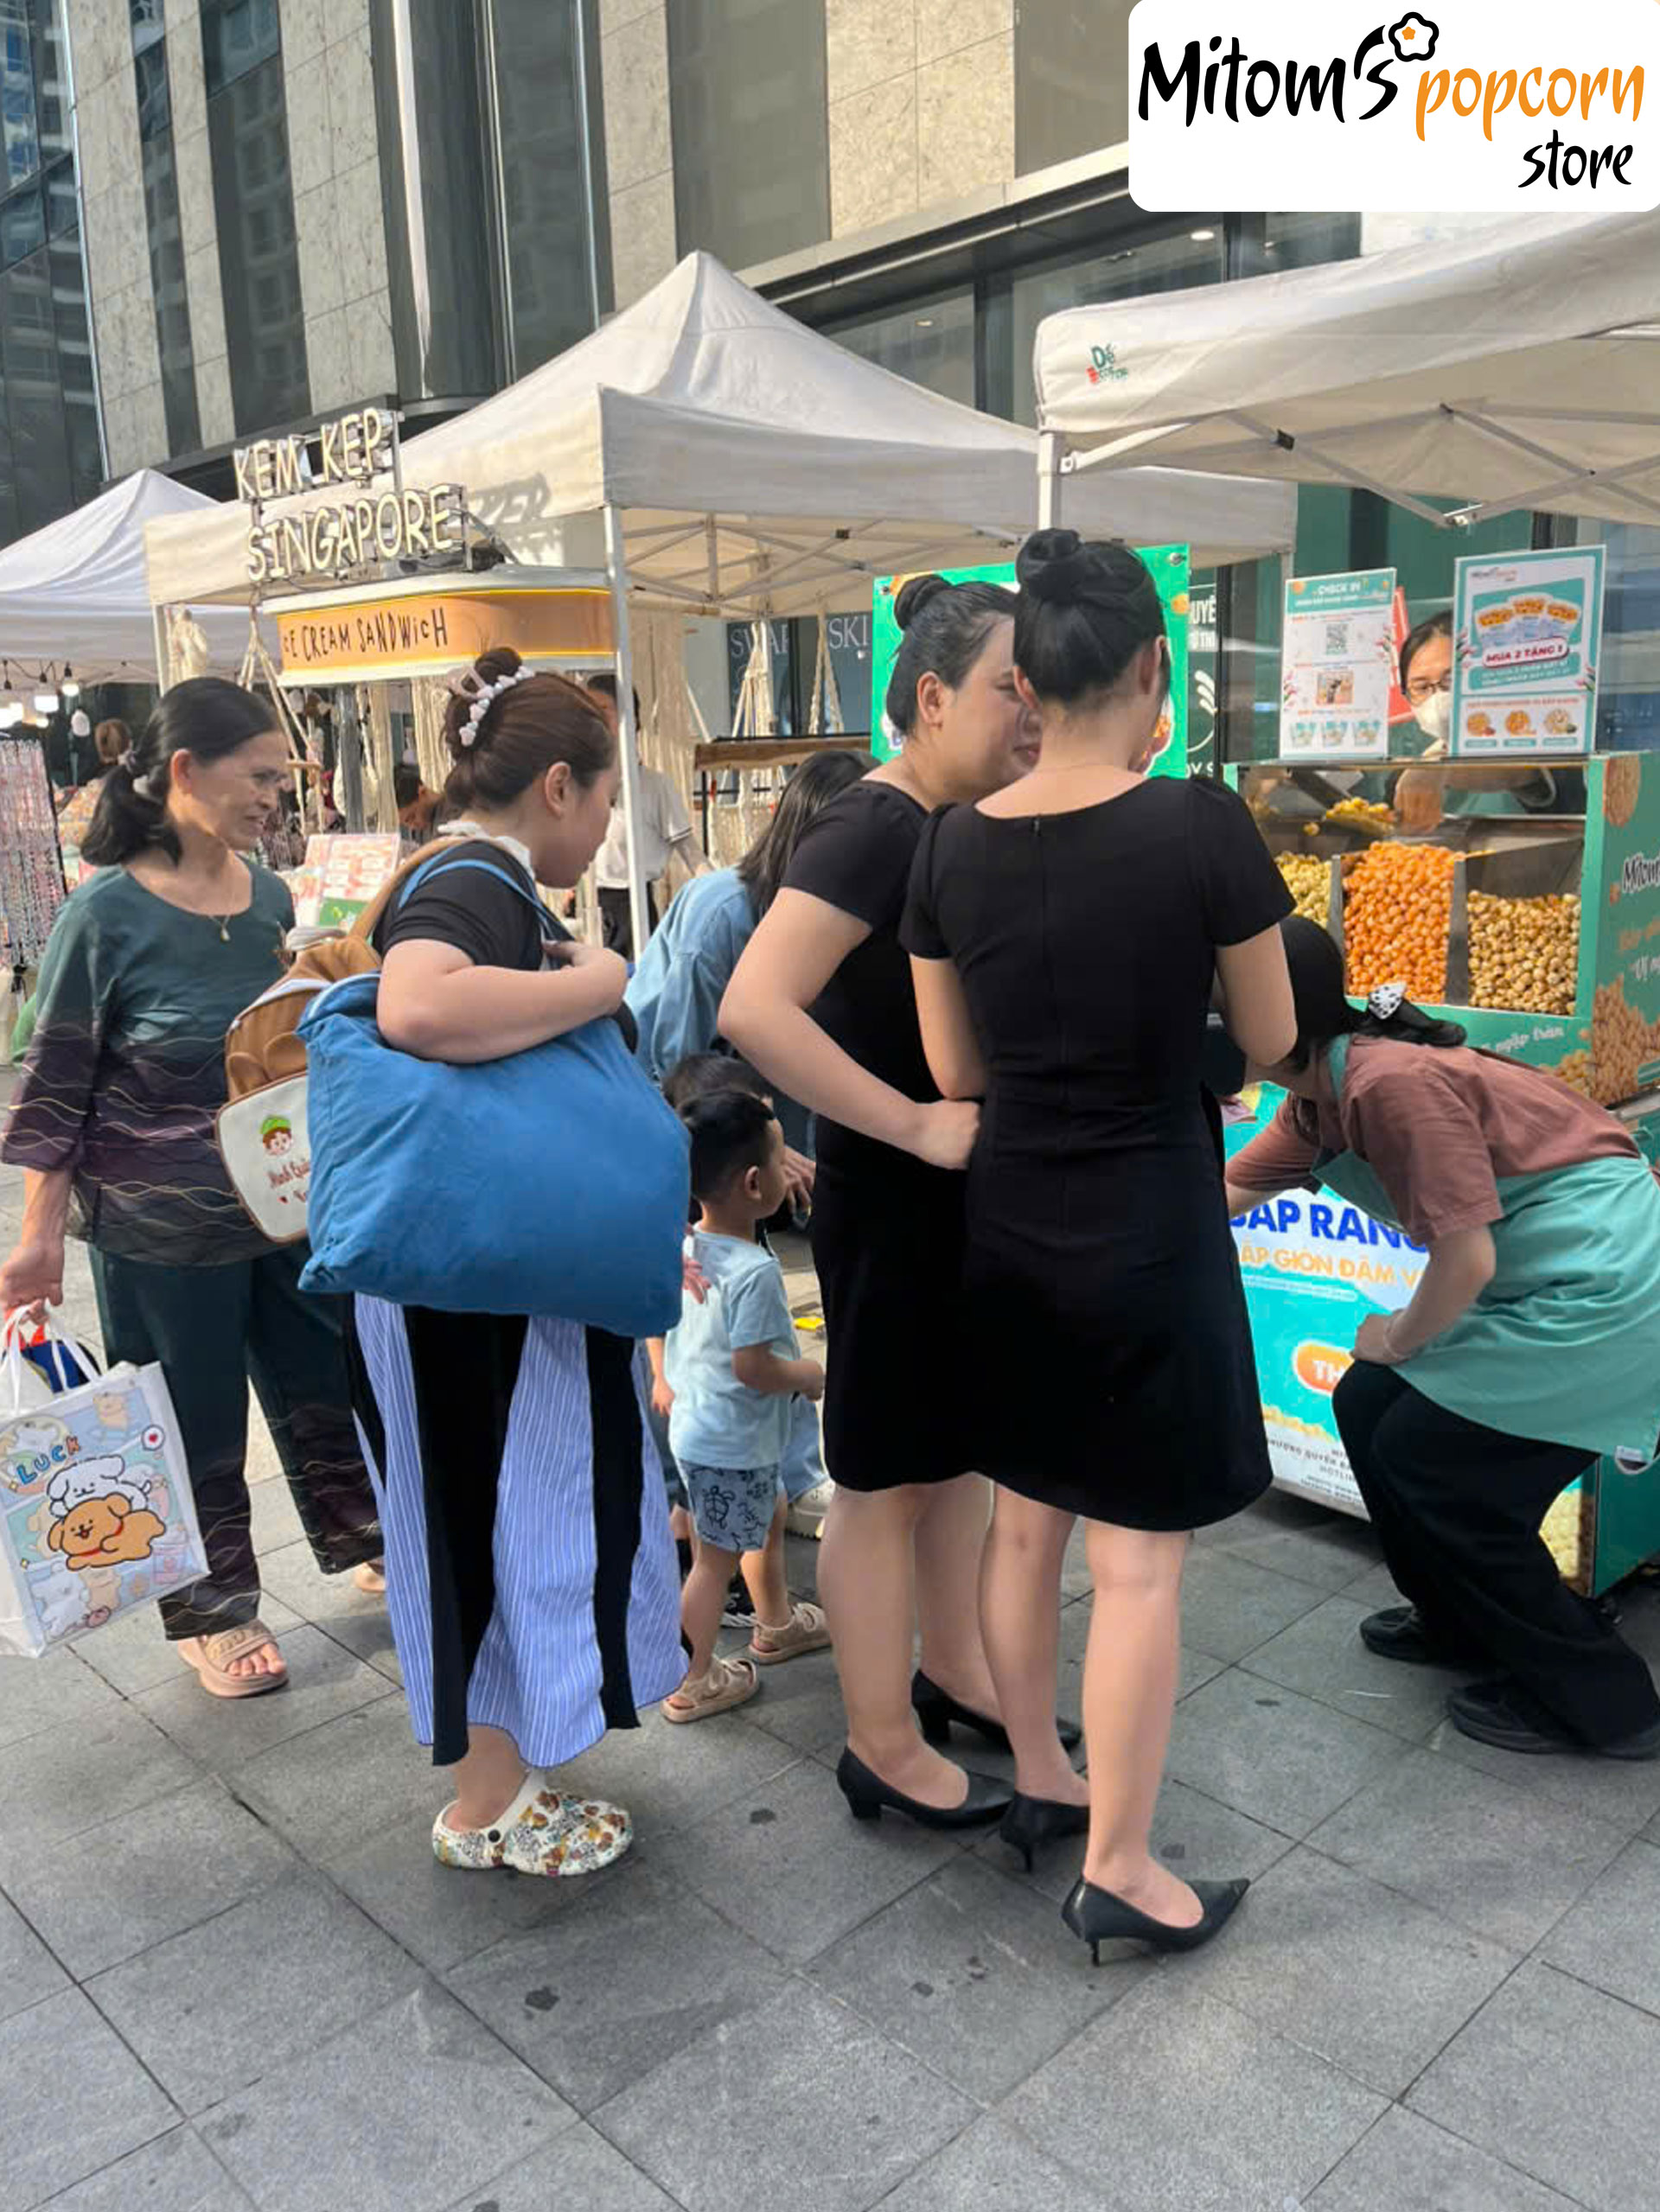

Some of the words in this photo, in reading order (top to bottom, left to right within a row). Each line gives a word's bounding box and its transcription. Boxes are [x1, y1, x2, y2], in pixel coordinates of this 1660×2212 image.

[233, 435, 304, 502] KEM
[247, 485, 452, 582] SINGAPORE
[303, 623, 351, 661] CREAM
[16, 1435, 80, 1485] LUCK
